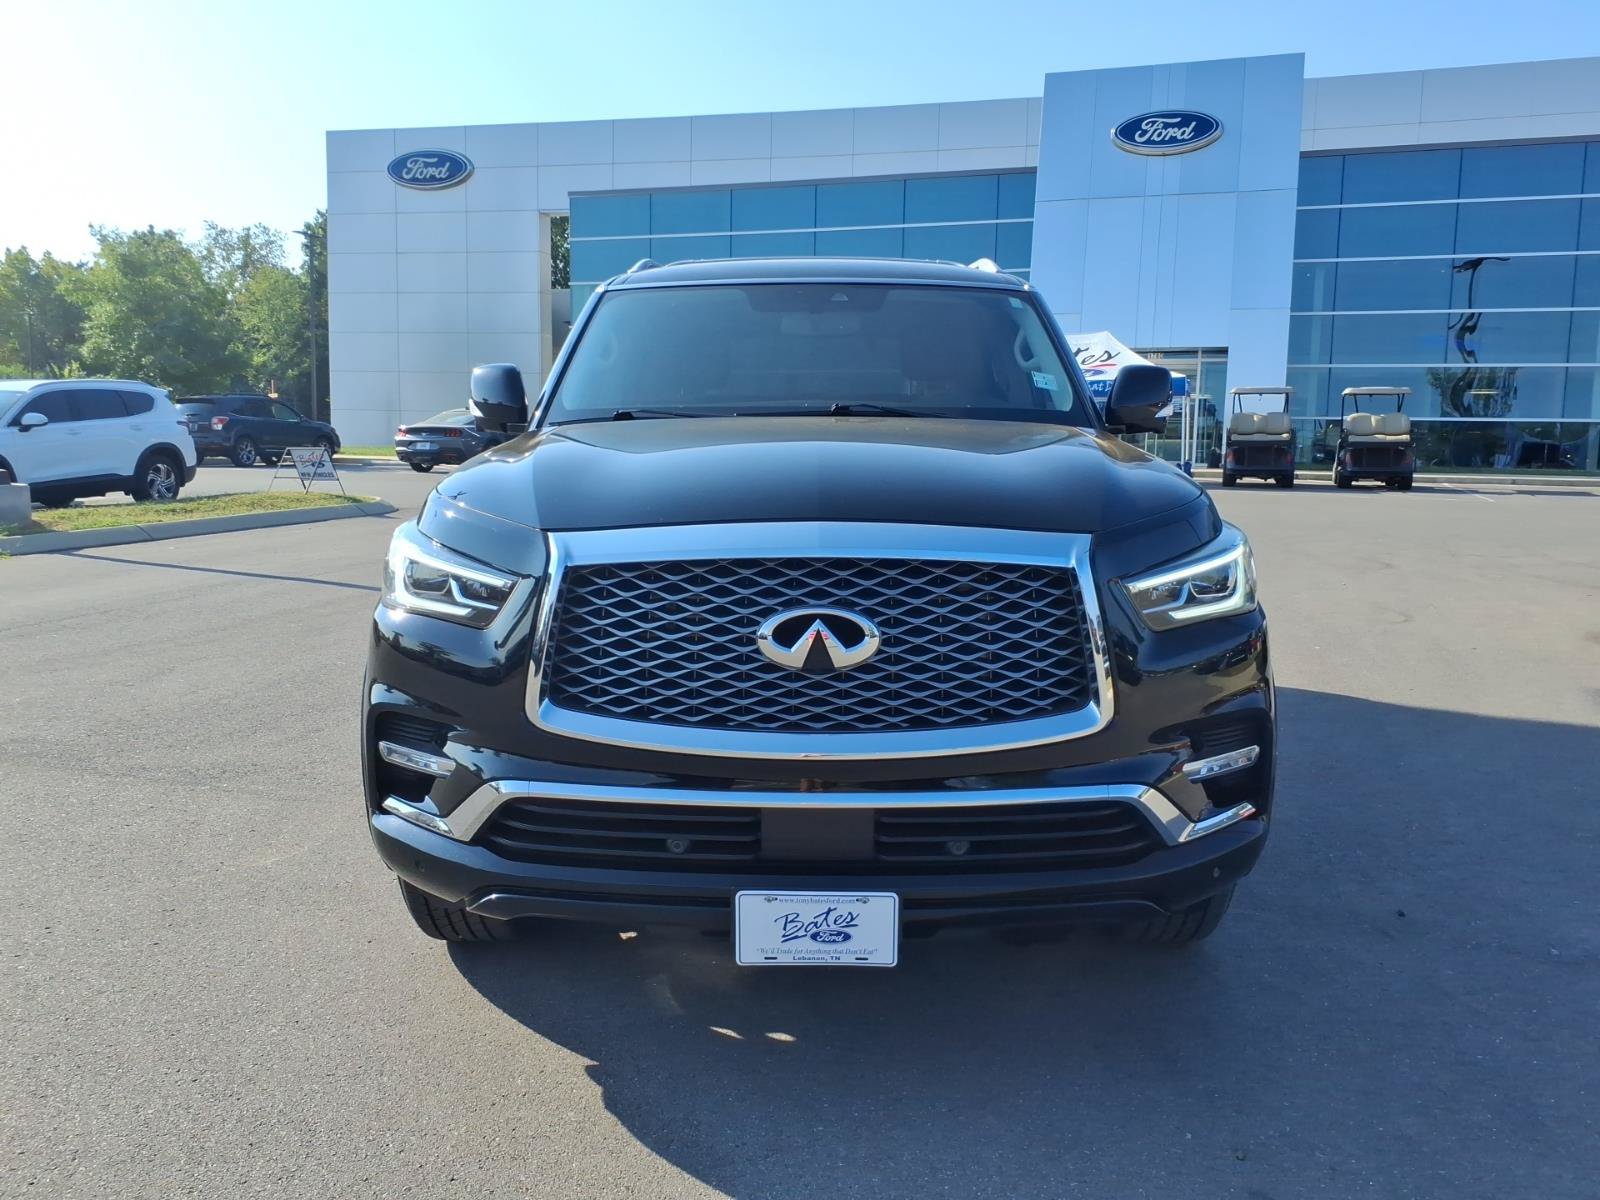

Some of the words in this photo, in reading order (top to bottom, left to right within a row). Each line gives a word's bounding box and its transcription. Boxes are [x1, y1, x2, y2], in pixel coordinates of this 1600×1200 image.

[1134, 117, 1197, 143] Ford
[402, 157, 451, 180] Ford
[774, 906, 861, 938] Bates
[816, 930, 846, 943] Ford
[793, 948, 804, 956] for
[804, 948, 830, 957] Anything
